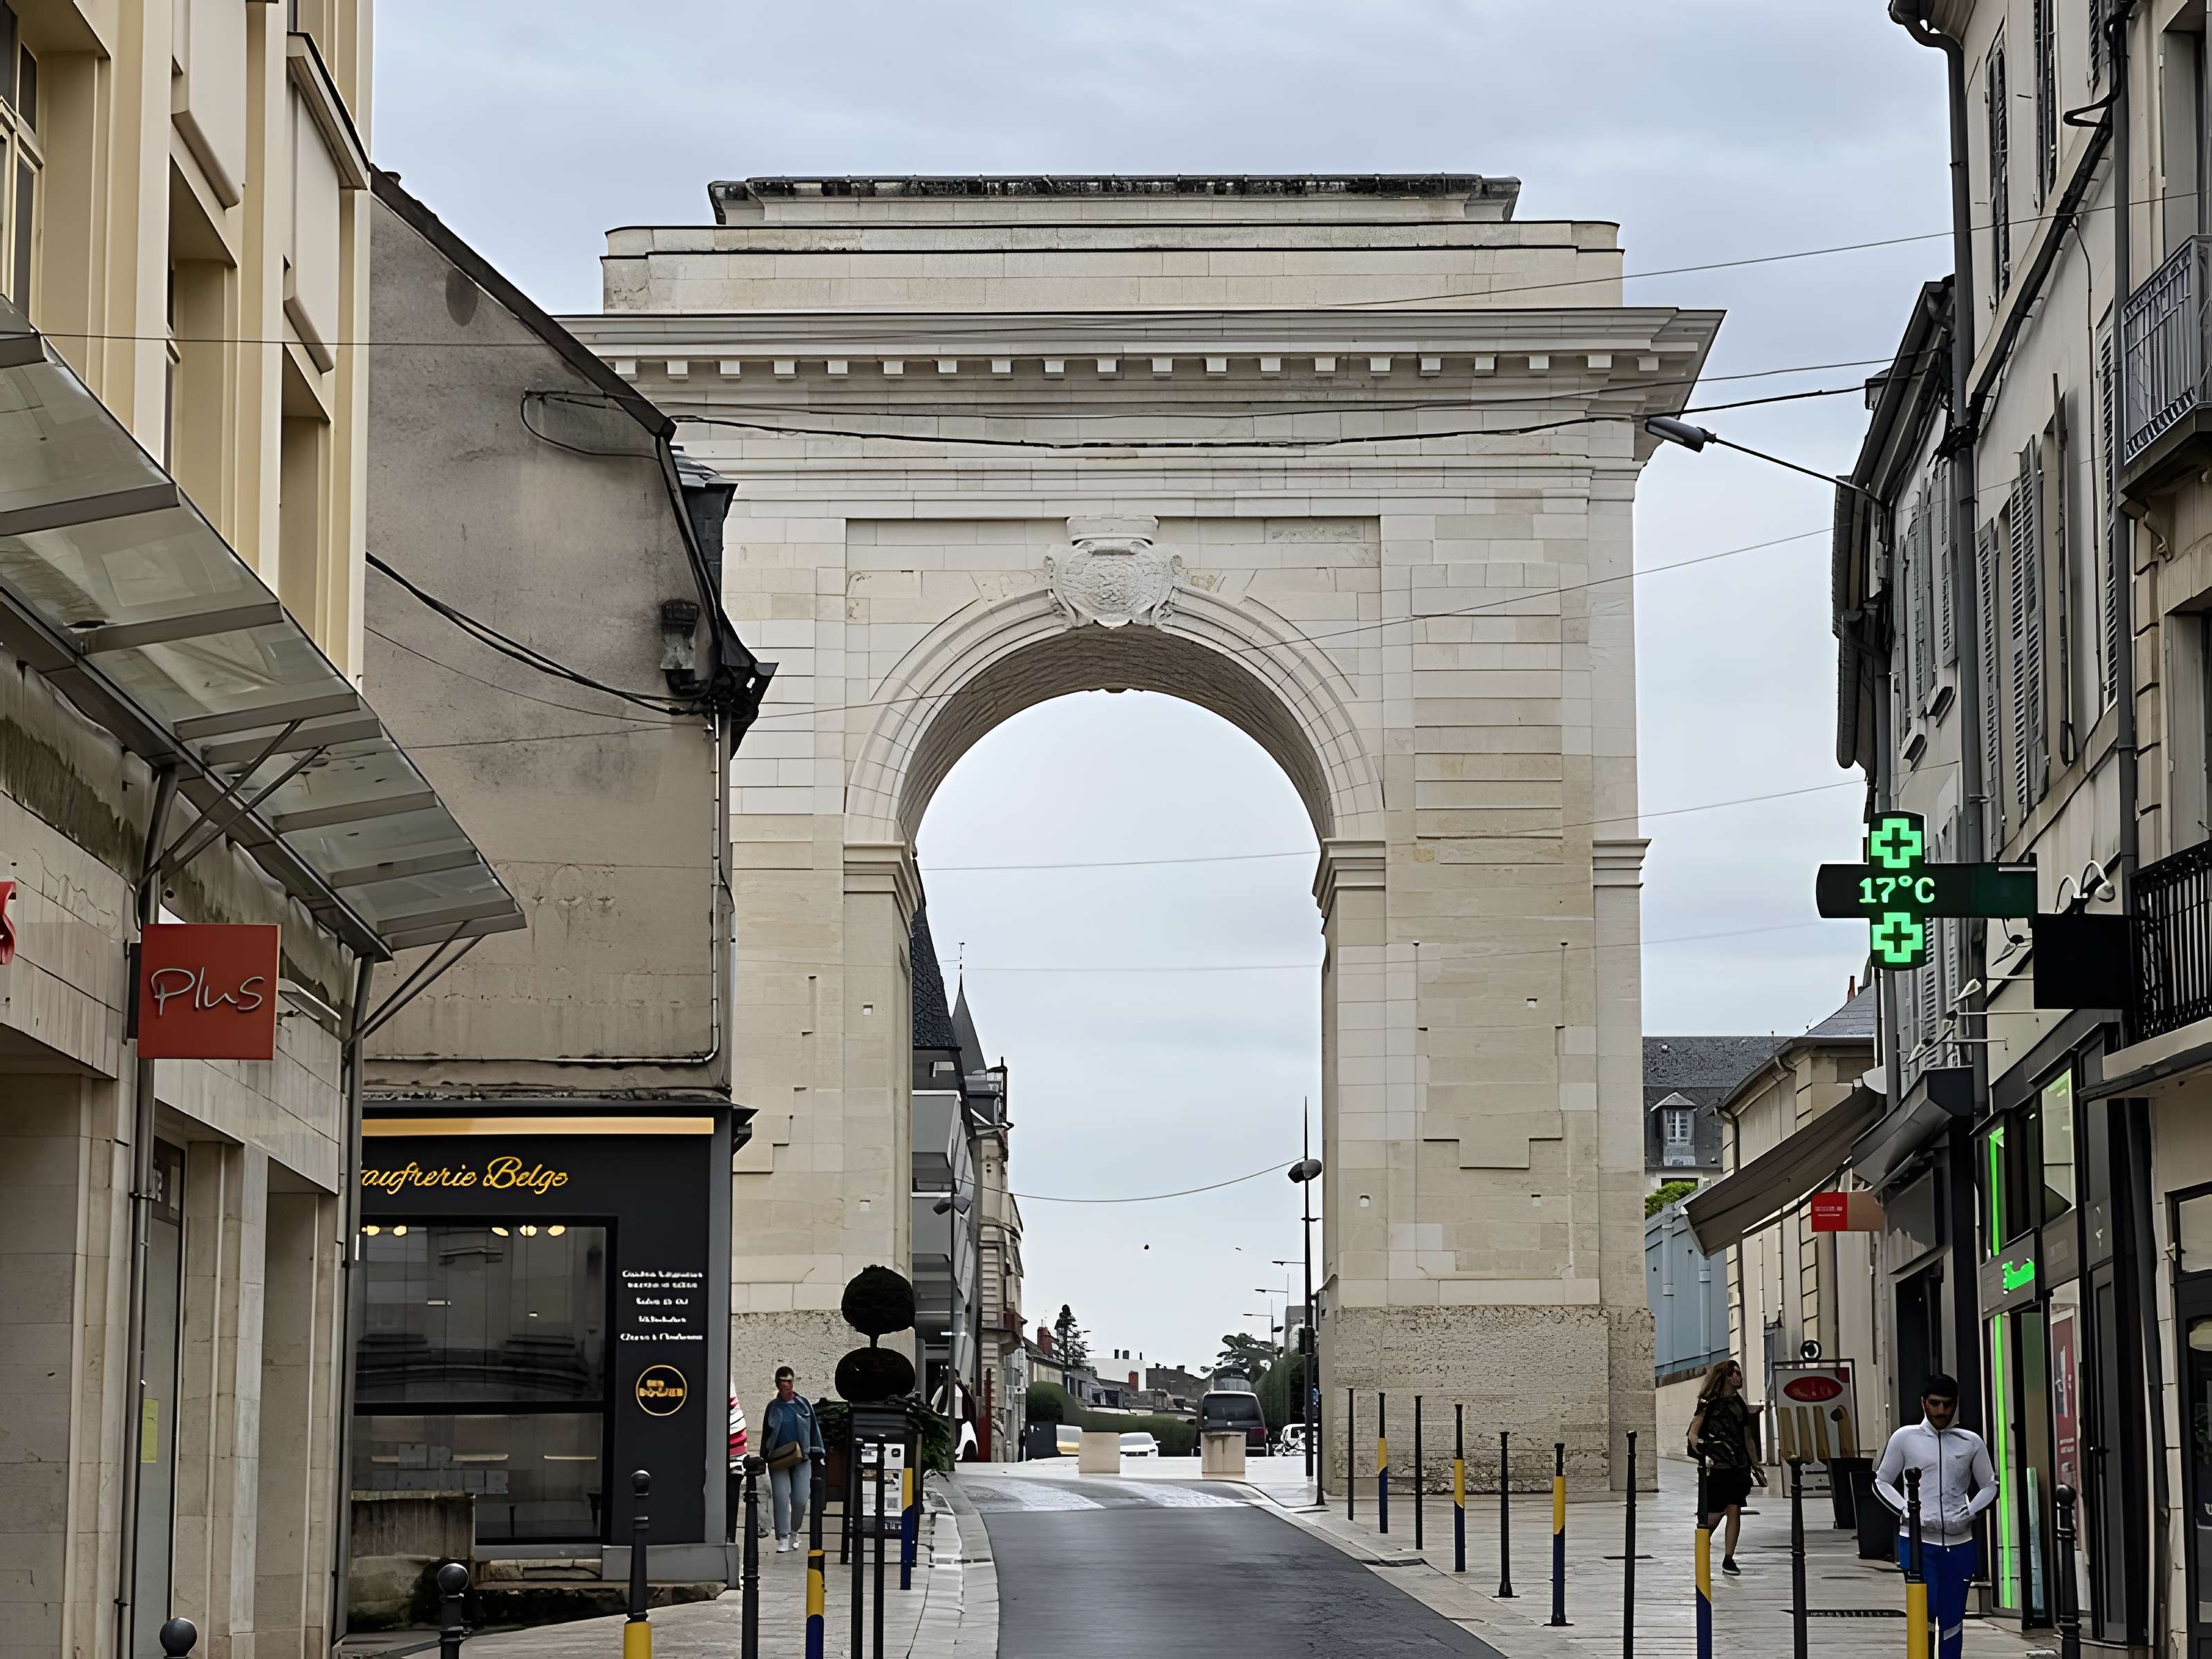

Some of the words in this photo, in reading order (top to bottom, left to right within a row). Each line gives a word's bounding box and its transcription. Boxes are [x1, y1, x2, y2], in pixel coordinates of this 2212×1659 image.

[1859, 875, 1935, 903] 17°C
[151, 967, 265, 1015] Plus
[361, 1161, 477, 1194] aufrerie
[482, 1156, 569, 1194] Belge
